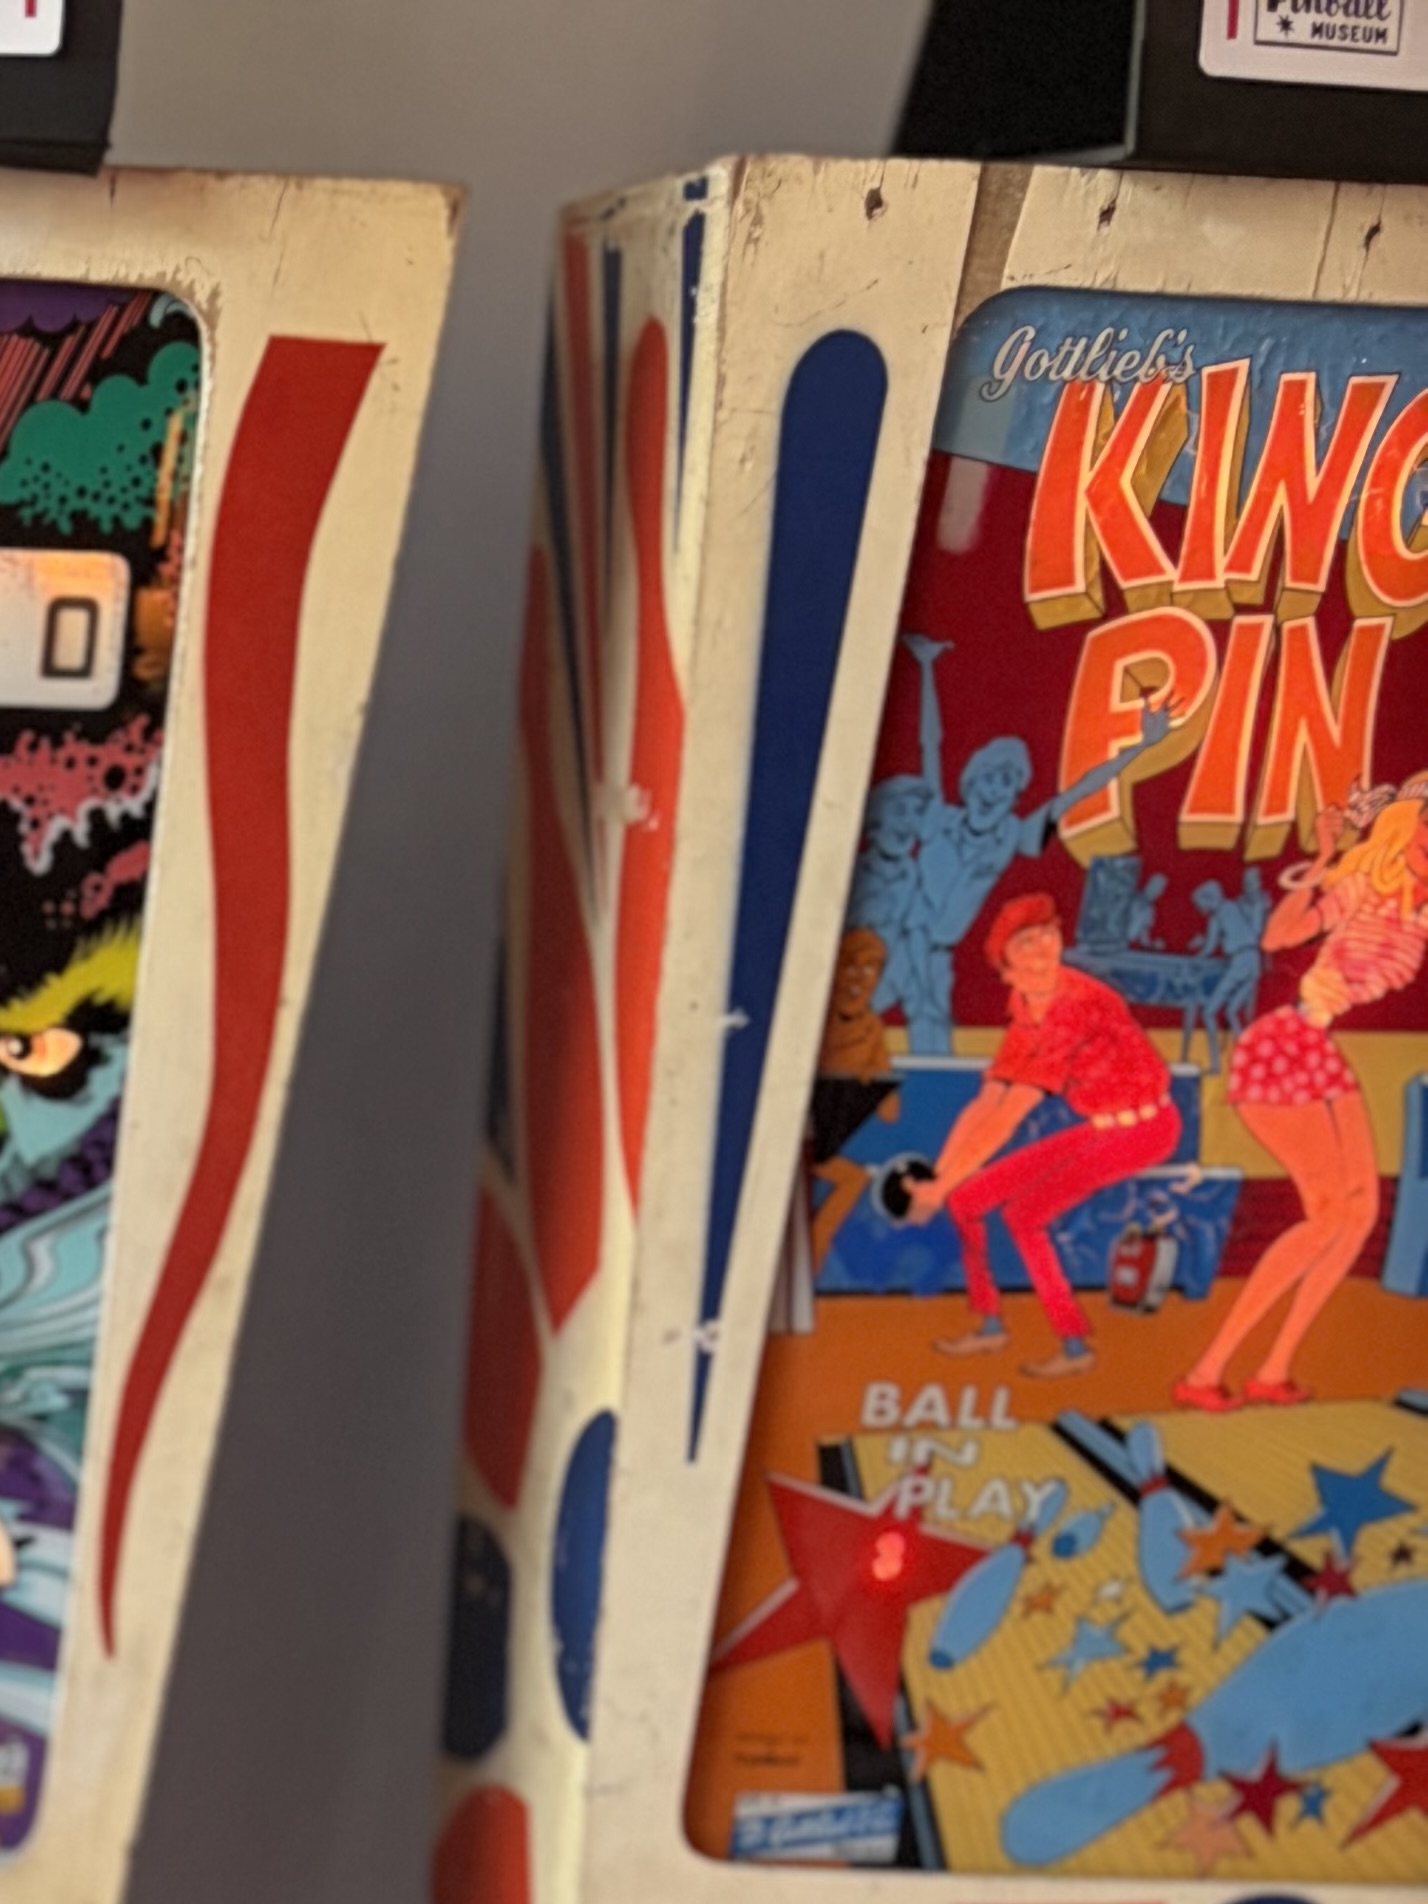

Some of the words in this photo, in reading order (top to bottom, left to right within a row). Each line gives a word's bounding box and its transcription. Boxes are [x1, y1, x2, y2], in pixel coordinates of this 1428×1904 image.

[1311, 22, 1388, 44] MUSEUM
[980, 326, 1195, 400] Gottlieb's
[1058, 606, 1396, 862] PIN
[860, 1381, 1019, 1432] BALL
[887, 1434, 981, 1468] IN
[894, 1476, 1066, 1529] PLAY
